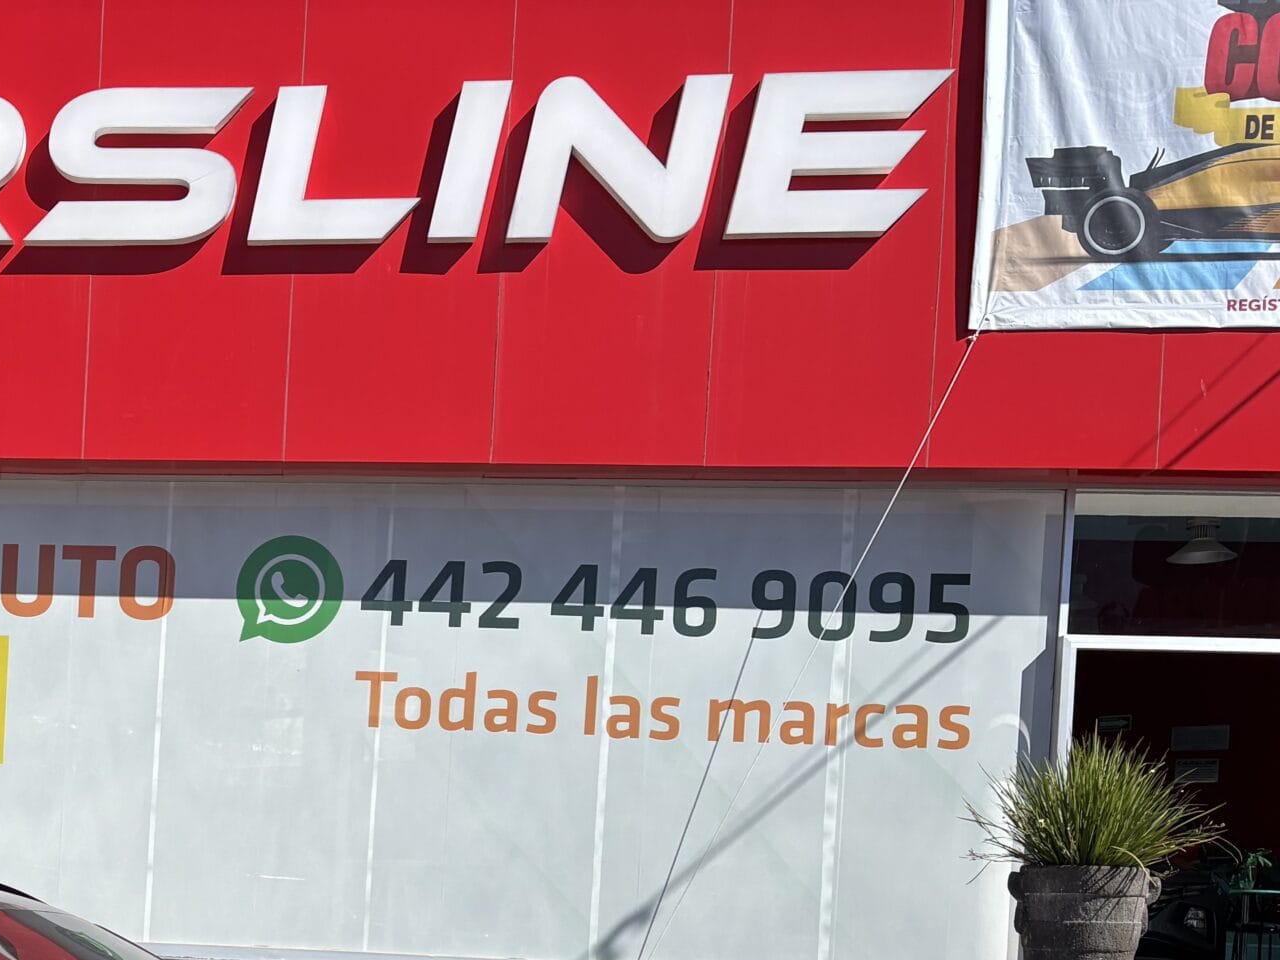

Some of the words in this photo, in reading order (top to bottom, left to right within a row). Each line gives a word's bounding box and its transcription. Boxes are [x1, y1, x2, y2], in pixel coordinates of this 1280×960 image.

[1245, 115, 1275, 139] DE
[360, 559, 522, 630] 442
[550, 564, 718, 638] 446
[751, 569, 972, 644] 9095
[355, 670, 557, 737] Todas
[583, 675, 681, 741] las
[707, 697, 971, 751] marcas
